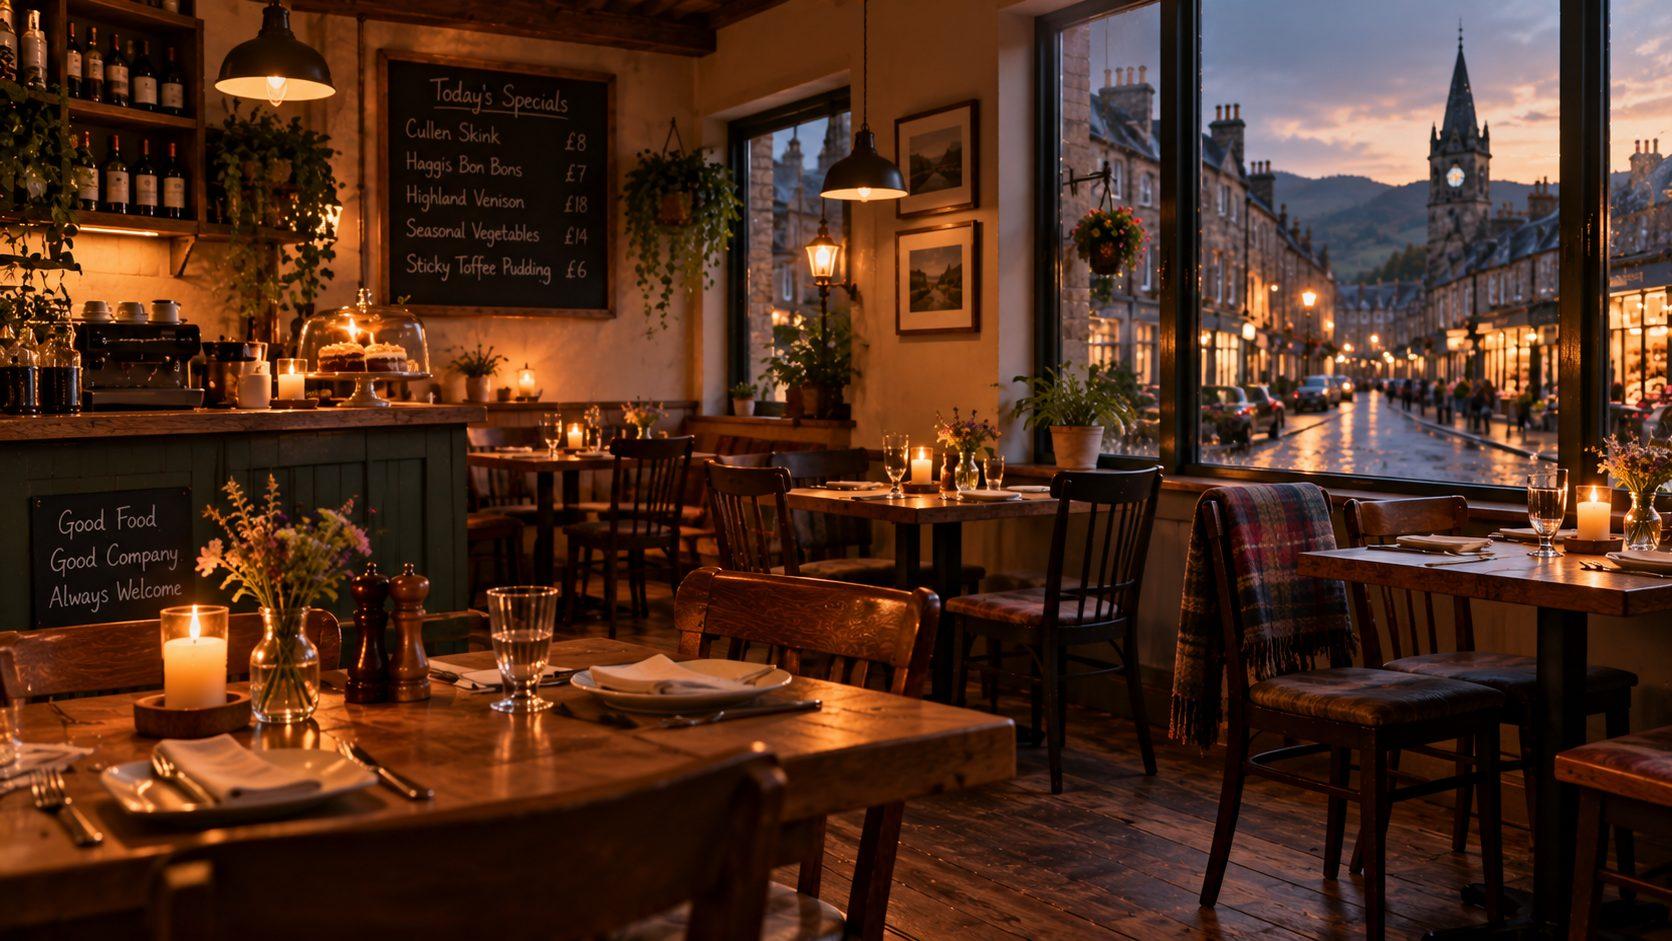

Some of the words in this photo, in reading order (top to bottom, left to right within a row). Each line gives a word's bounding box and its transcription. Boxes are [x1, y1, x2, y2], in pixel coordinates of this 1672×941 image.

[429, 77, 493, 115] Today's
[502, 83, 569, 118] Specials
[405, 118, 451, 141] Cullen
[458, 122, 500, 145] Skink
[564, 131, 587, 152] £8
[406, 151, 452, 179] Haggis
[459, 155, 485, 175] Bon
[490, 156, 523, 178] Bons
[565, 164, 587, 183] £7
[406, 184, 467, 213] Highland
[473, 188, 525, 209] Venison
[563, 195, 588, 213] £18
[406, 218, 466, 239] Seasonal
[471, 221, 540, 248] Vegetables
[564, 226, 588, 245] £14
[406, 253, 450, 282] Sticky
[455, 255, 497, 281] Toffee
[502, 256, 551, 285] Pudding
[565, 260, 587, 279] £6
[58, 508, 106, 540] Good
[115, 504, 158, 530] Food
[50, 546, 98, 578] Good
[106, 542, 178, 572] Company
[49, 584, 110, 613] Always
[116, 577, 182, 601] Welcome
